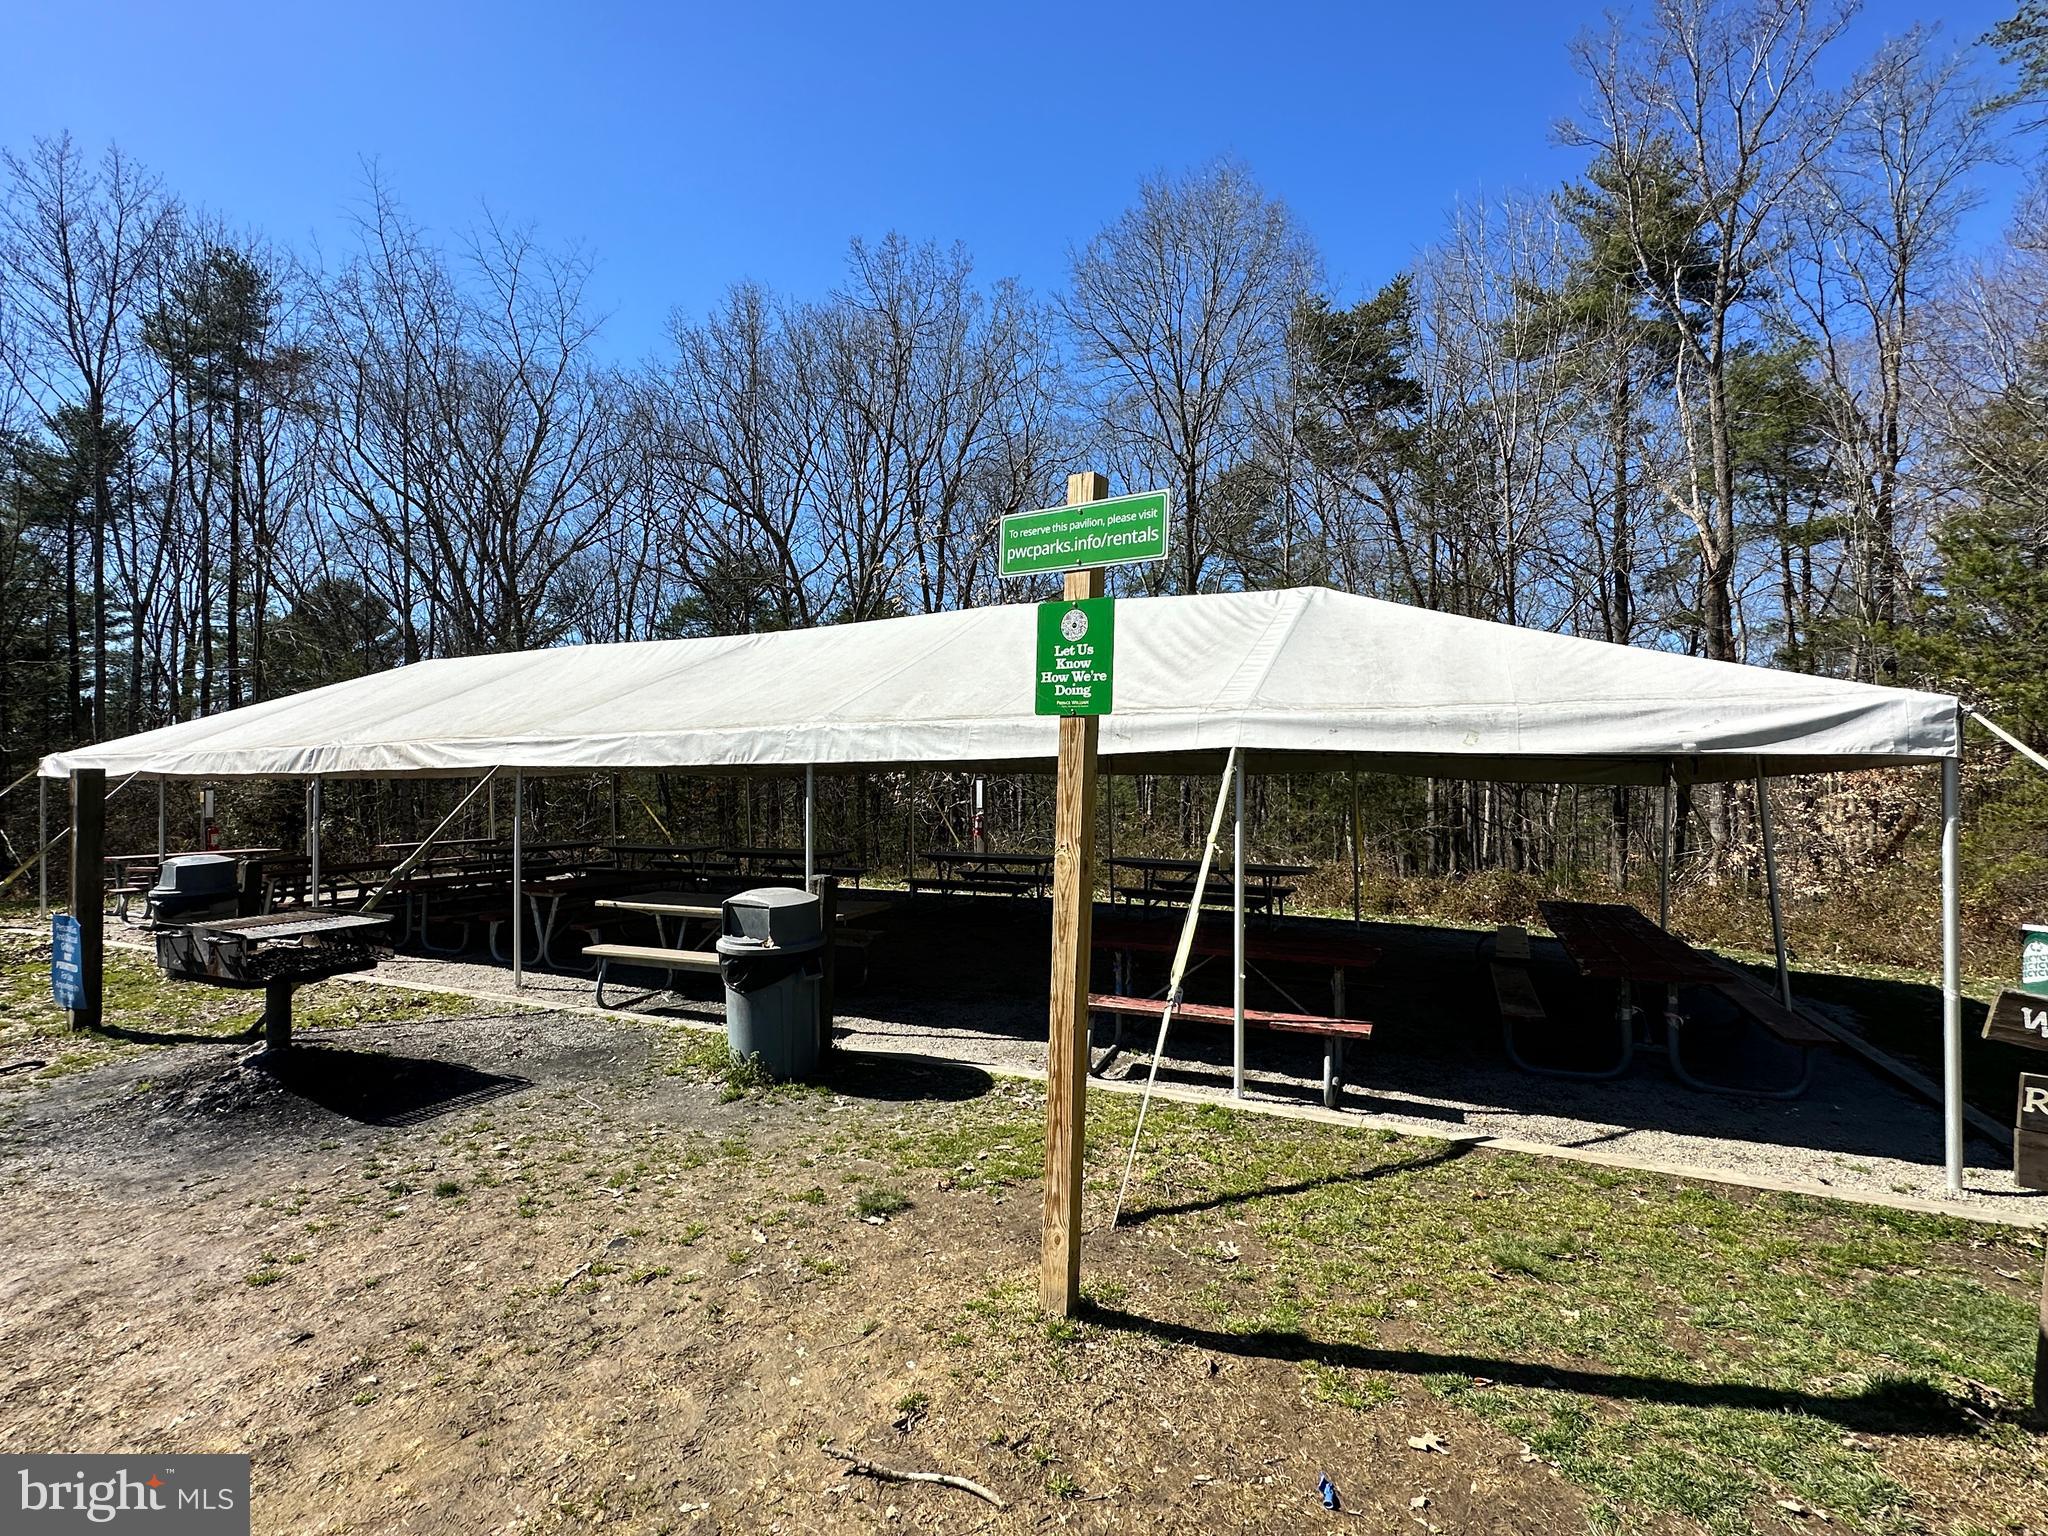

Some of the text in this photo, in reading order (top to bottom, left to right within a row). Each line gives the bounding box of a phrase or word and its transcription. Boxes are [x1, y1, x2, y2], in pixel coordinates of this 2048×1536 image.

[1009, 508, 1158, 538] To reserve this pavilion, please visit
[1007, 525, 1159, 564] pwcparks.info/rentals
[1054, 643, 1094, 657] Let Us
[1055, 658, 1092, 670] Know
[1040, 669, 1107, 683] How We're
[1054, 683, 1092, 698] Doing
